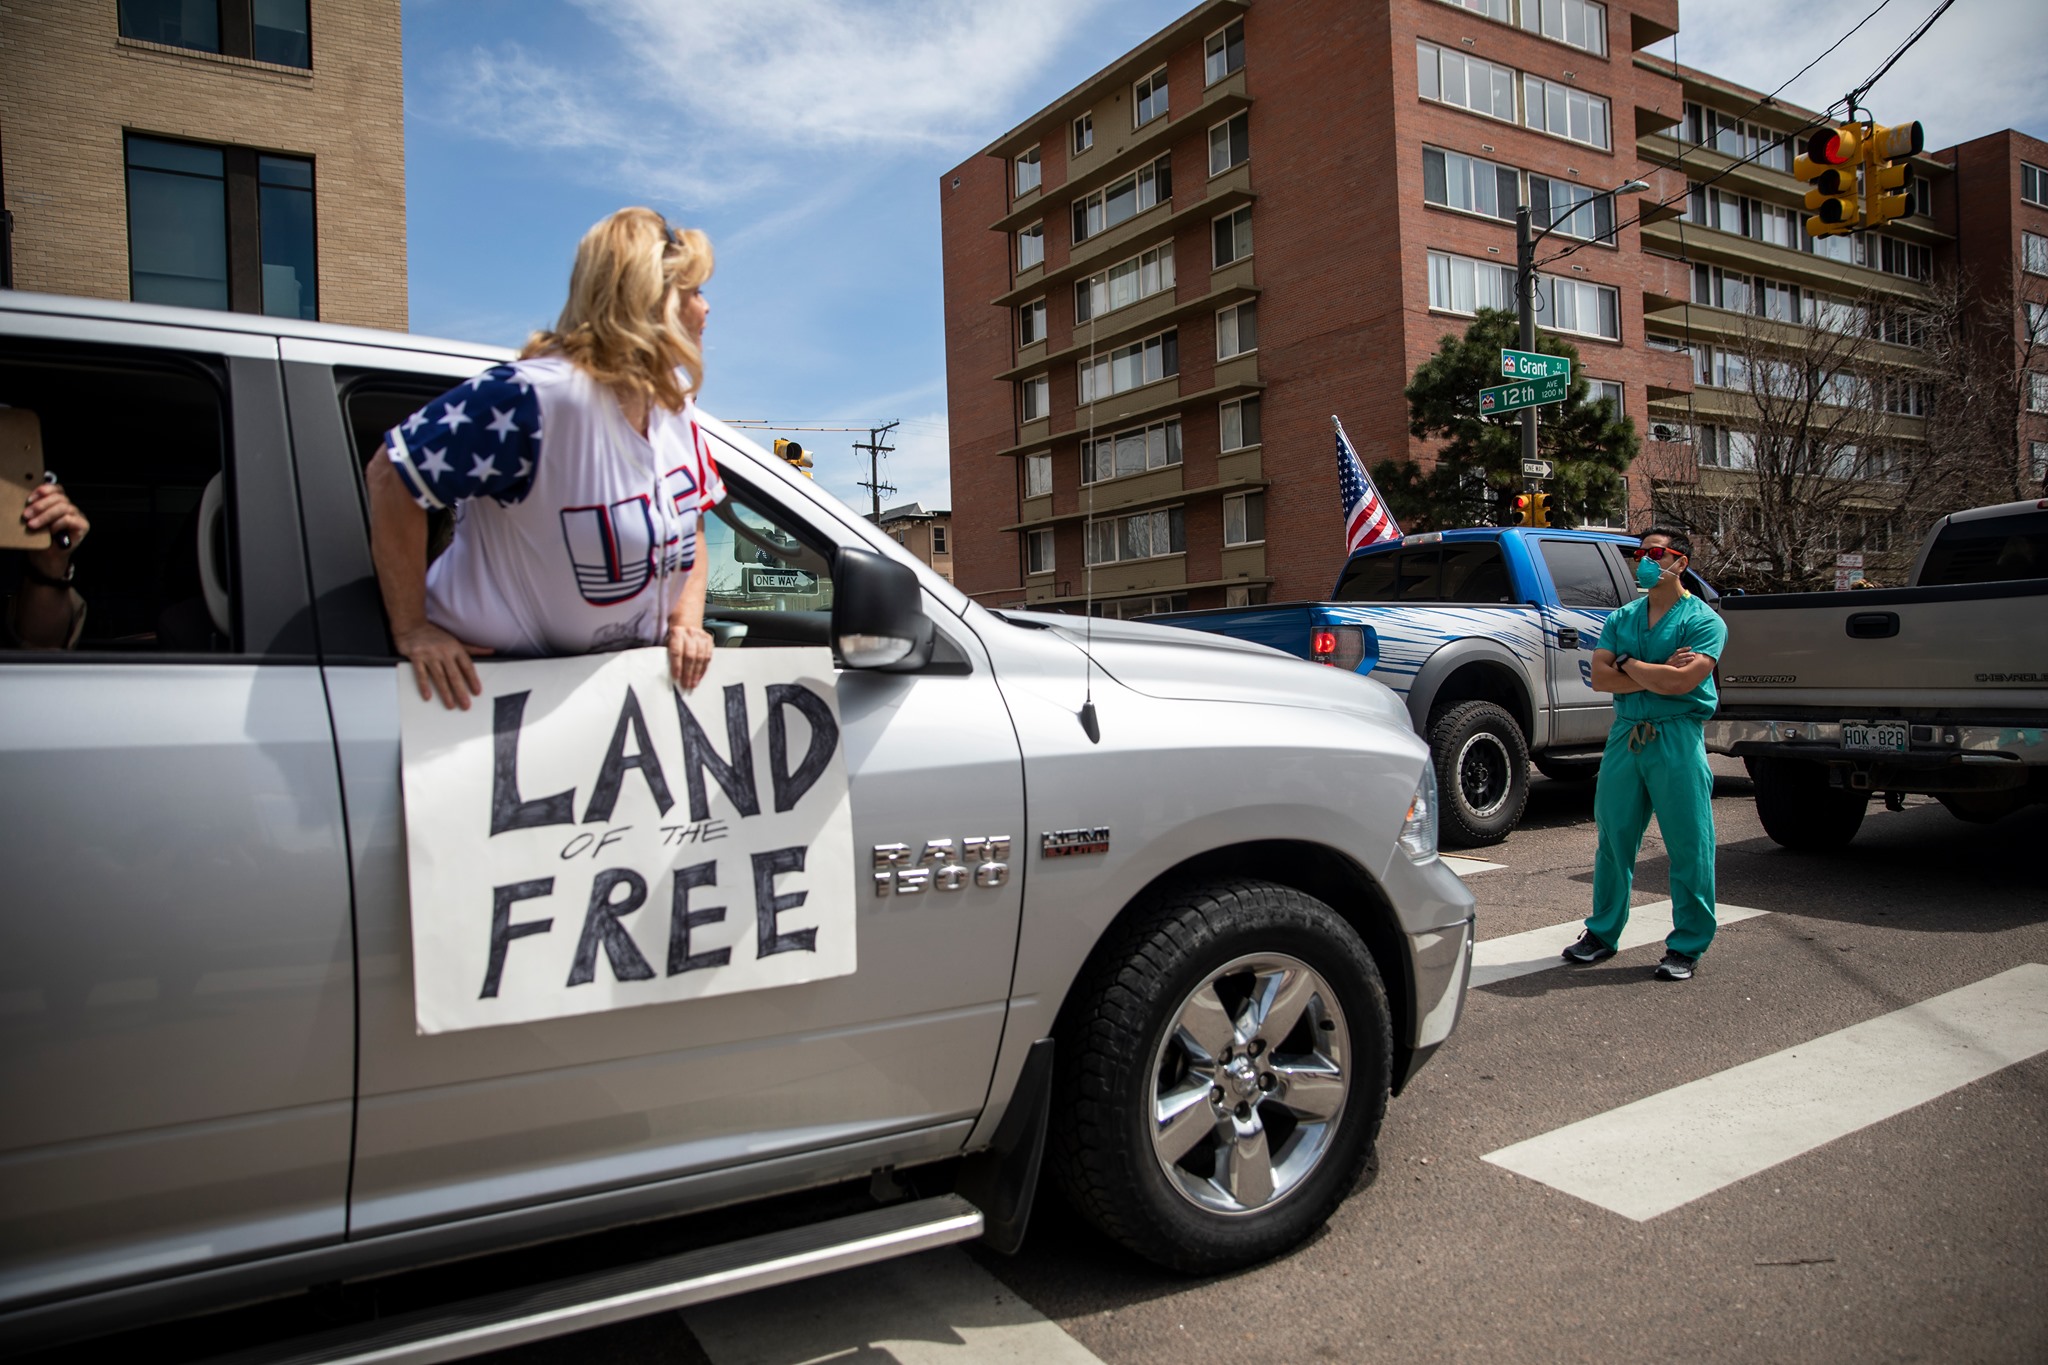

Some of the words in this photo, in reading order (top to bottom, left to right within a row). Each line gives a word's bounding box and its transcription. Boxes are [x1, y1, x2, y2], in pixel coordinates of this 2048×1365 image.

[1520, 357, 1548, 377] Grant
[1502, 385, 1535, 406] 12th
[1546, 379, 1558, 389] AVE
[1542, 389, 1557, 399] 1200
[1558, 388, 1564, 396] N
[1525, 464, 1534, 472] ONE
[755, 575, 775, 586] ONE
[777, 576, 798, 587] WAY
[1736, 674, 1797, 684] SILVERADO
[489, 682, 839, 838] LAND
[560, 825, 633, 860] OF
[659, 819, 729, 846] THE
[1042, 826, 1109, 846] HEMI
[873, 835, 1011, 869] RAM
[874, 862, 1010, 897] 1500
[477, 845, 819, 1000] FREE
